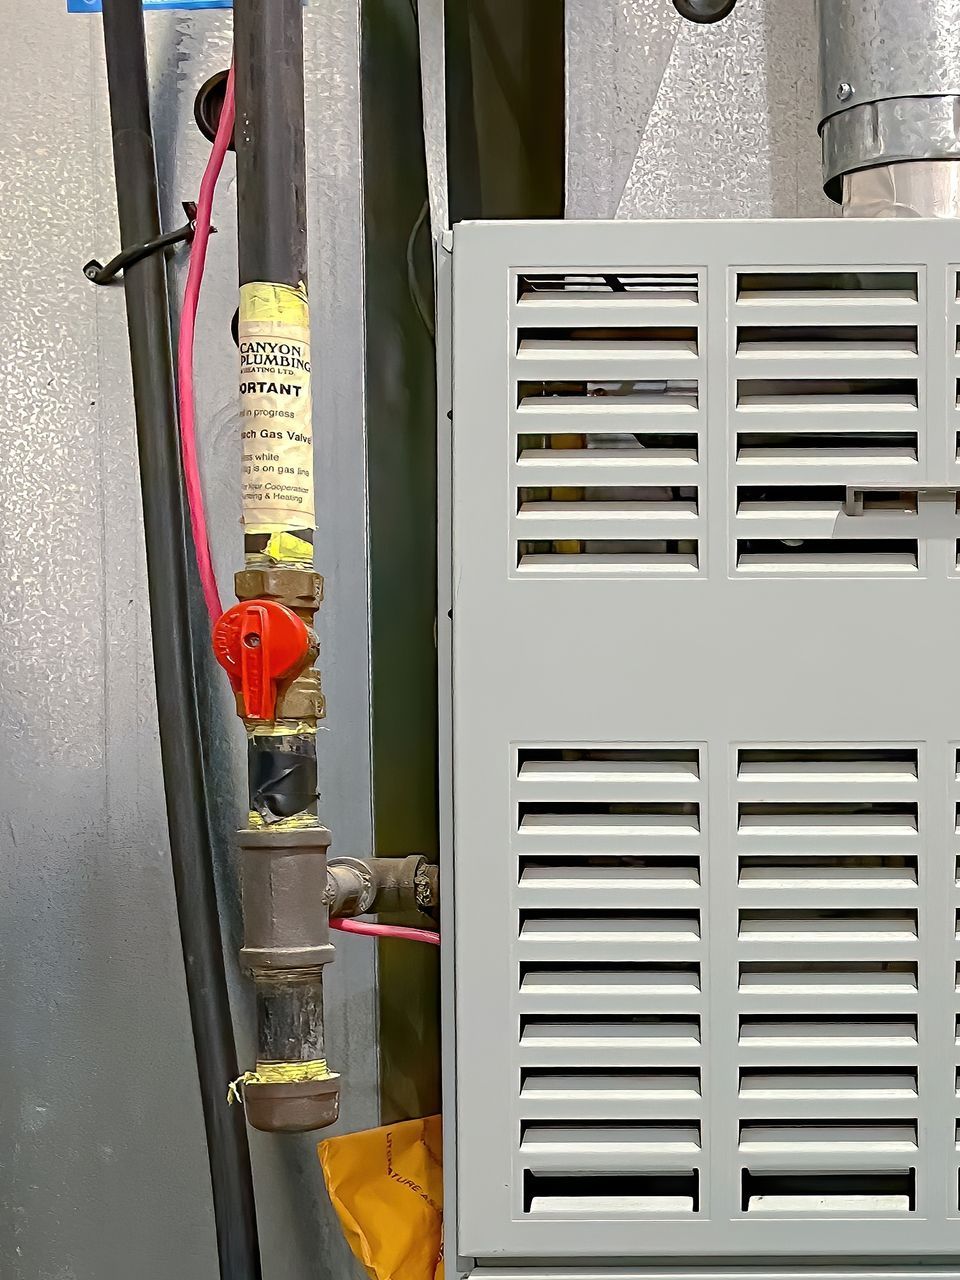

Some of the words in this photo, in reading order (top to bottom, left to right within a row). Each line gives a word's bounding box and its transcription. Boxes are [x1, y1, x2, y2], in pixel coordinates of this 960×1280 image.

[240, 342, 300, 357] CANYON
[240, 354, 311, 373] PLUMBING
[254, 409, 295, 418] progress
[260, 429, 282, 439] Gas
[287, 431, 311, 444] Valve
